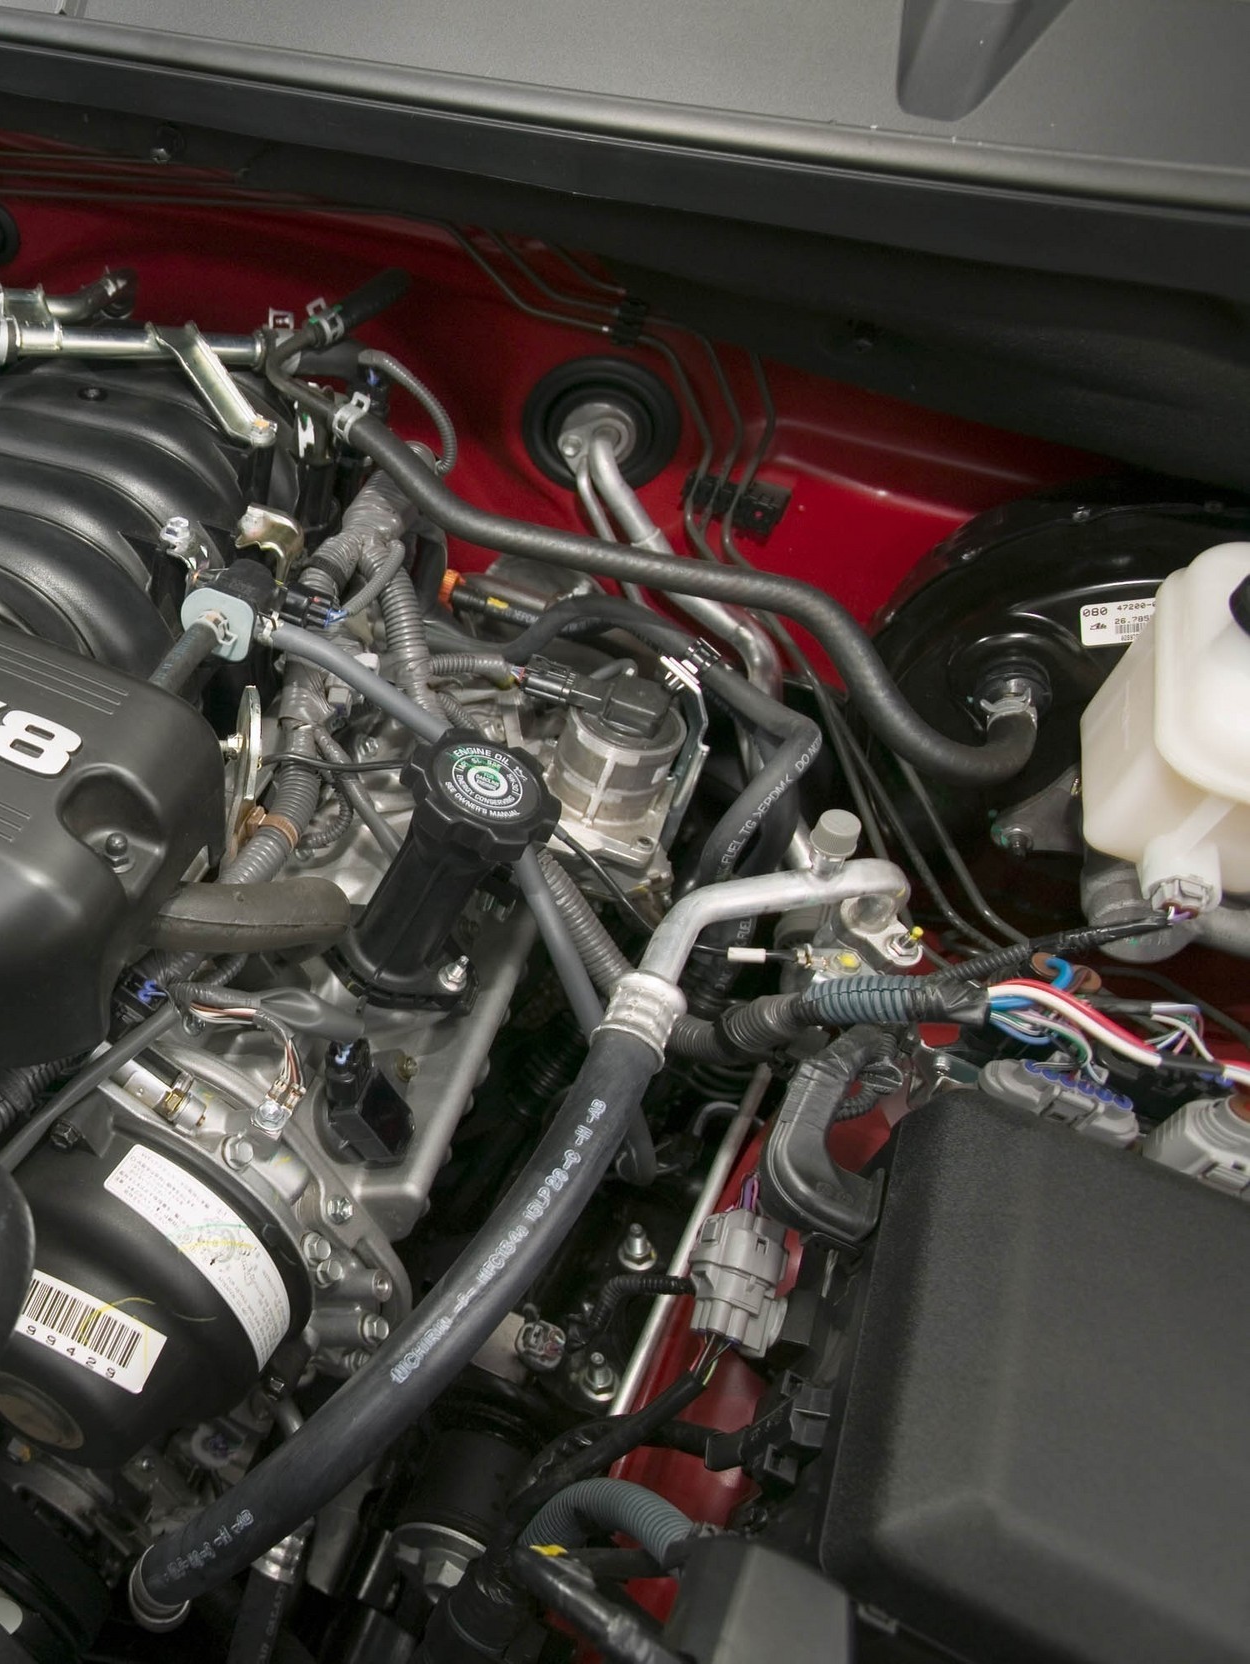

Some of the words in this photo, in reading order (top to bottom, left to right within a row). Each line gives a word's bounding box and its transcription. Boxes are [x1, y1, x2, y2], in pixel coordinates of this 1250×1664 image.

[1082, 607, 1108, 617] 080
[452, 747, 492, 758] ENGINE
[494, 753, 510, 766] OIL
[794, 753, 810, 772] DO
[489, 809, 521, 819] MANUAL
